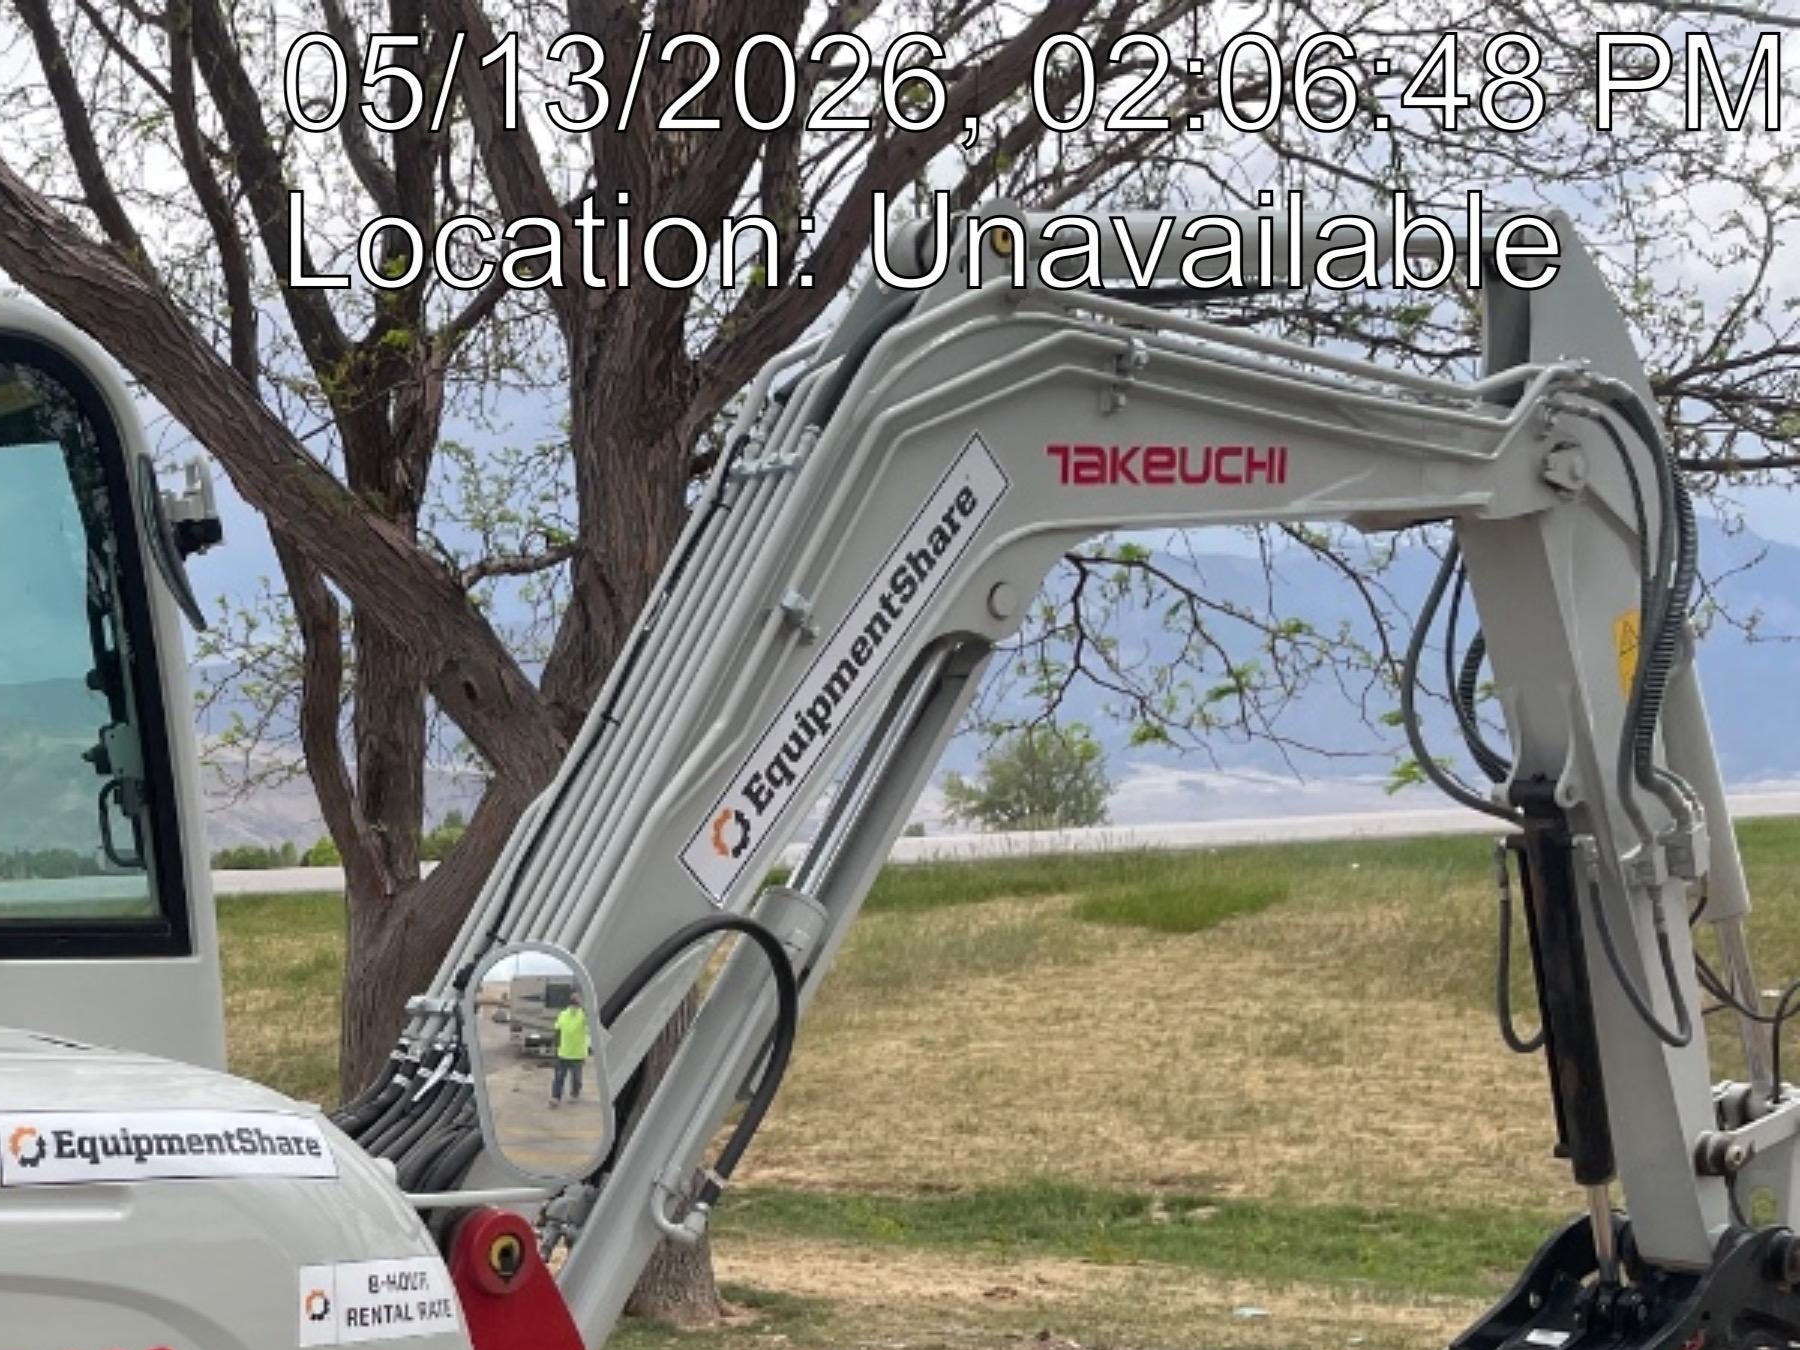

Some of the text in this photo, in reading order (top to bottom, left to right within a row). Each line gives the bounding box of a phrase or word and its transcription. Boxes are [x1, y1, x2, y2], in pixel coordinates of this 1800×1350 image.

[741, 484, 979, 816] EquipmentShare
[51, 1127, 323, 1164] EquipmentShare
[347, 1303, 414, 1327] RENTAL
